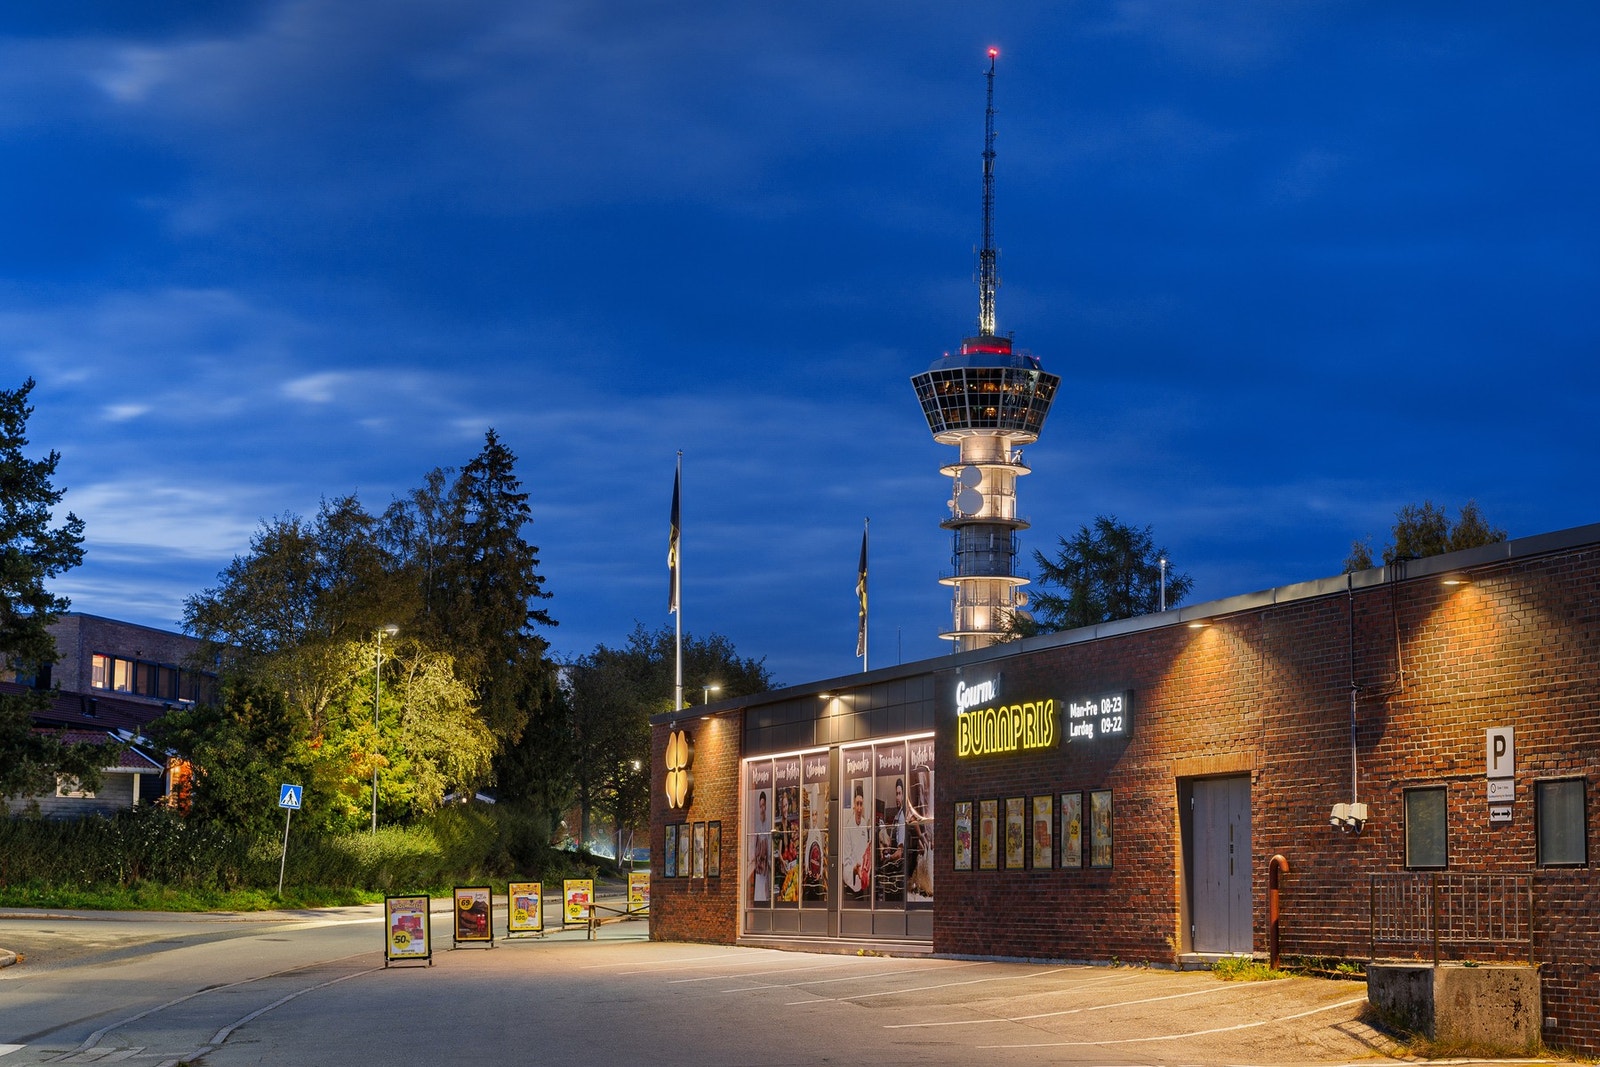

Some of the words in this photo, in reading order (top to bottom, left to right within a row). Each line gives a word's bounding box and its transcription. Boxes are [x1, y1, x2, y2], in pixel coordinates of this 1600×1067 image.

[1070, 701, 1098, 719] Man-Fre
[1101, 696, 1122, 715] 08-23
[1070, 721, 1093, 739] Lørdag
[1101, 716, 1122, 734] 09-22
[1493, 734, 1506, 770] P
